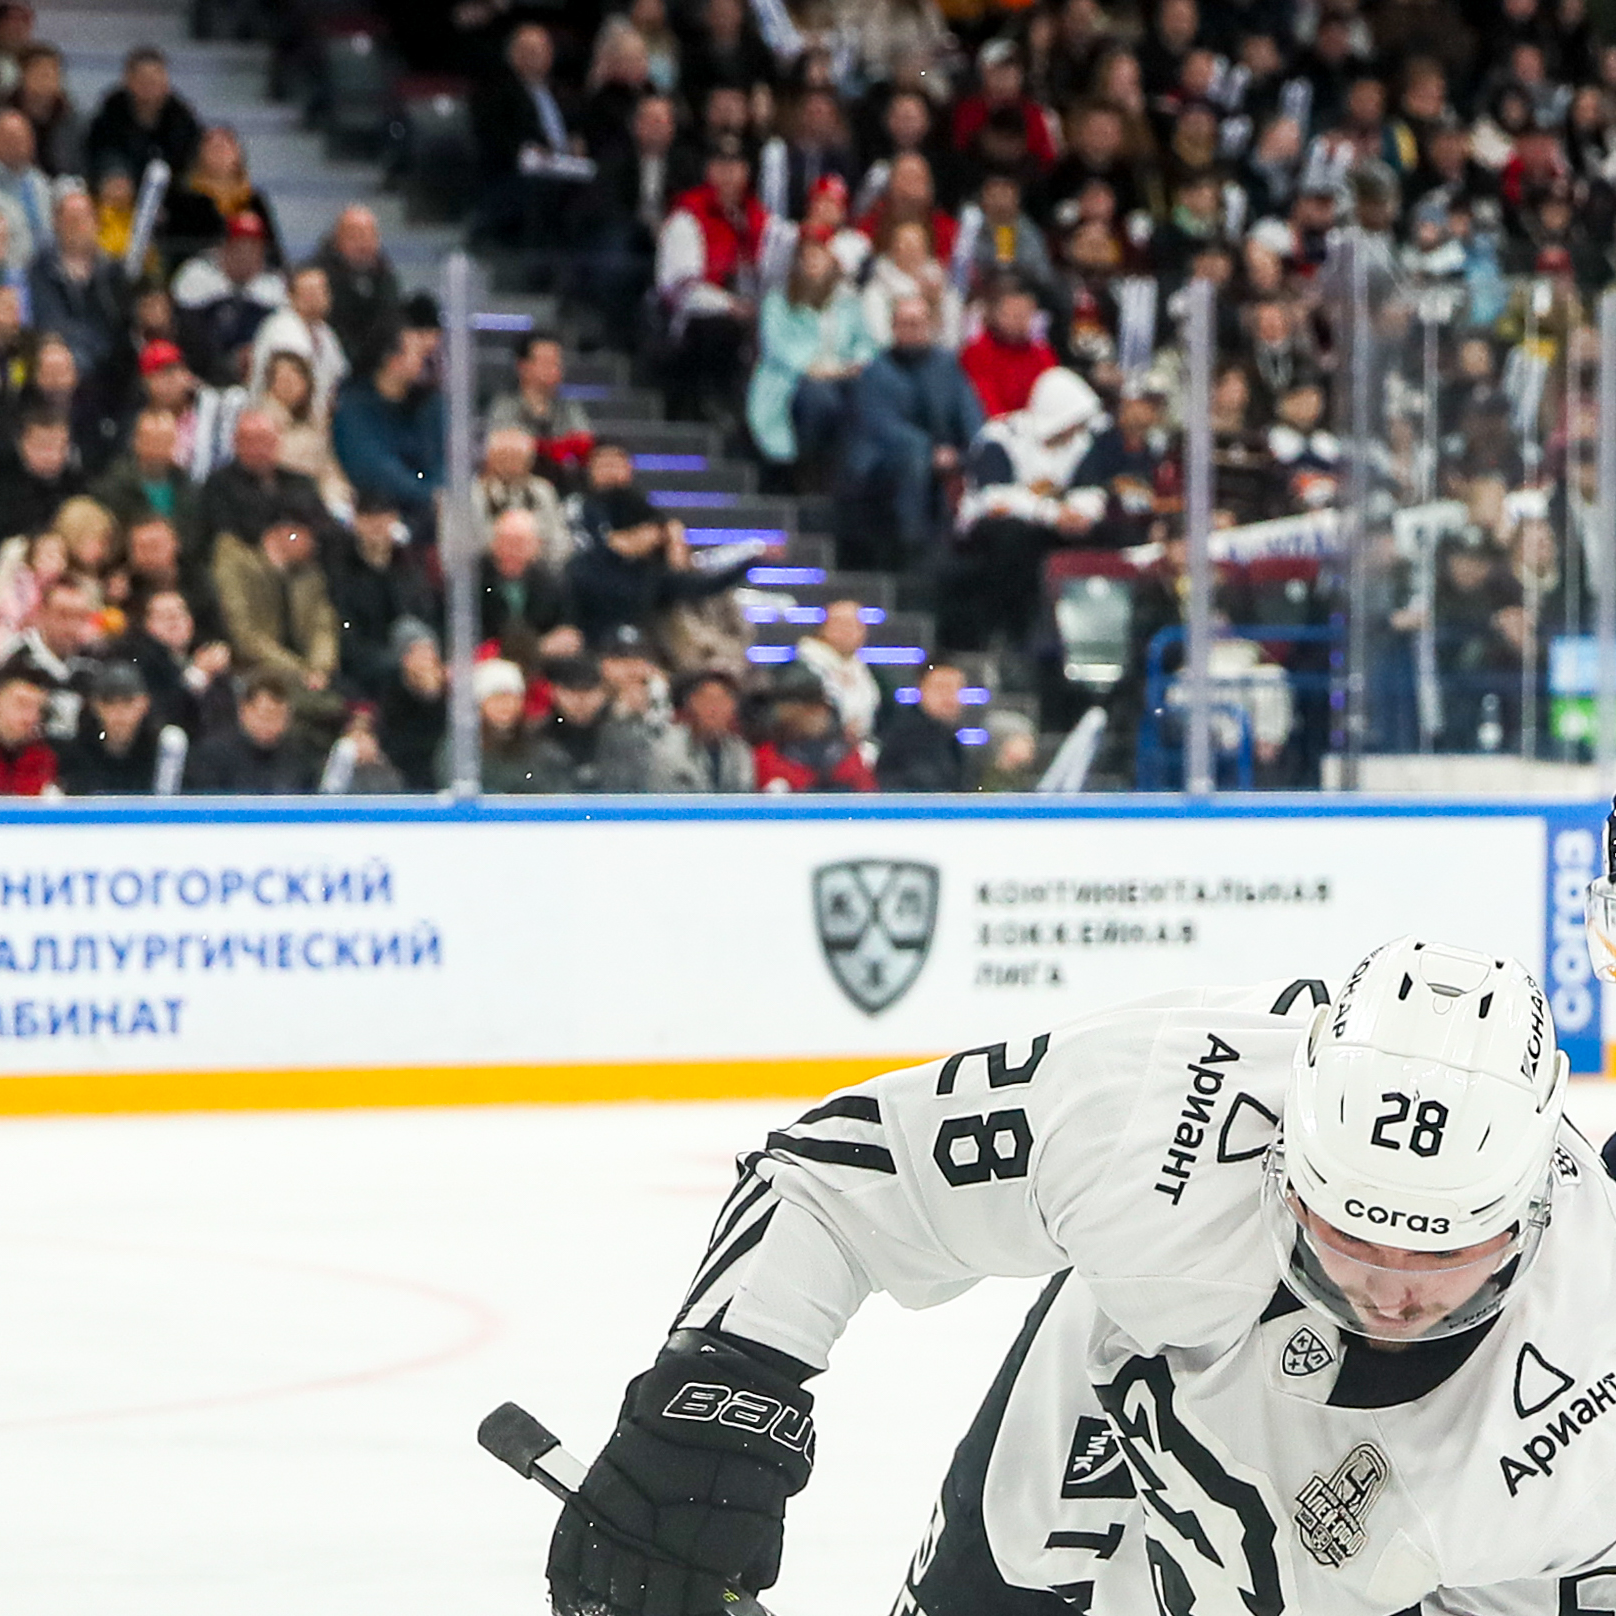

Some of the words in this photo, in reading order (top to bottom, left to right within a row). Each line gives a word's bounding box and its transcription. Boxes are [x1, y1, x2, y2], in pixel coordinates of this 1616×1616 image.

[933, 1032, 1052, 1188] 28
[1154, 1032, 1241, 1207] Ариант
[1370, 1091, 1449, 1158] 28
